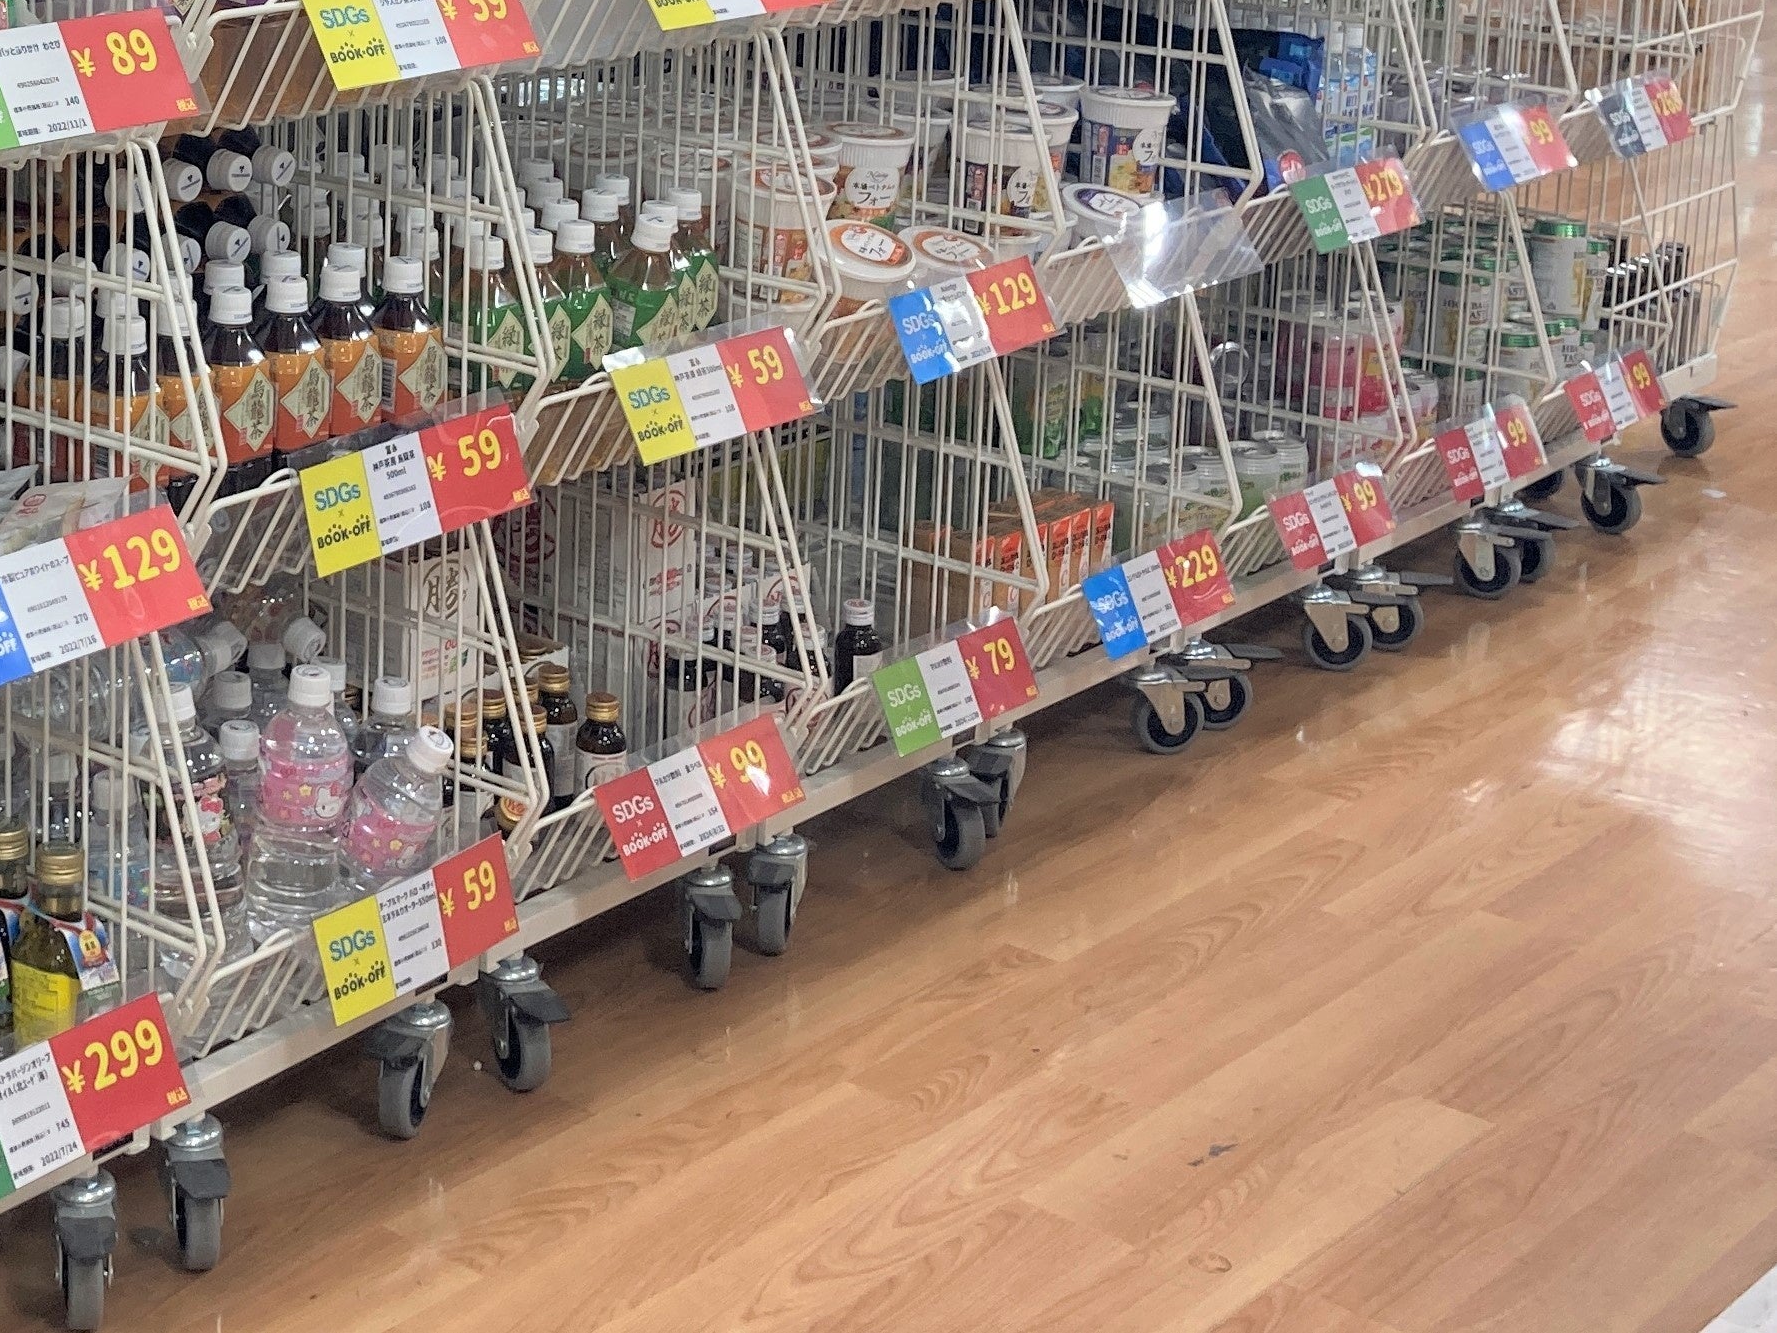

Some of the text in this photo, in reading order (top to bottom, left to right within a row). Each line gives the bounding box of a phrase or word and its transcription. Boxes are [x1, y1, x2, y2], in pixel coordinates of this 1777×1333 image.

[319, 3, 371, 28] SDGs
[64, 95, 81, 108] 140
[628, 384, 672, 410] SDGs
[313, 481, 363, 513] SDGs
[77, 527, 182, 592] ¥129
[612, 794, 655, 825] SDGs
[328, 927, 377, 963] SDGs
[60, 1019, 165, 1095] ¥299
